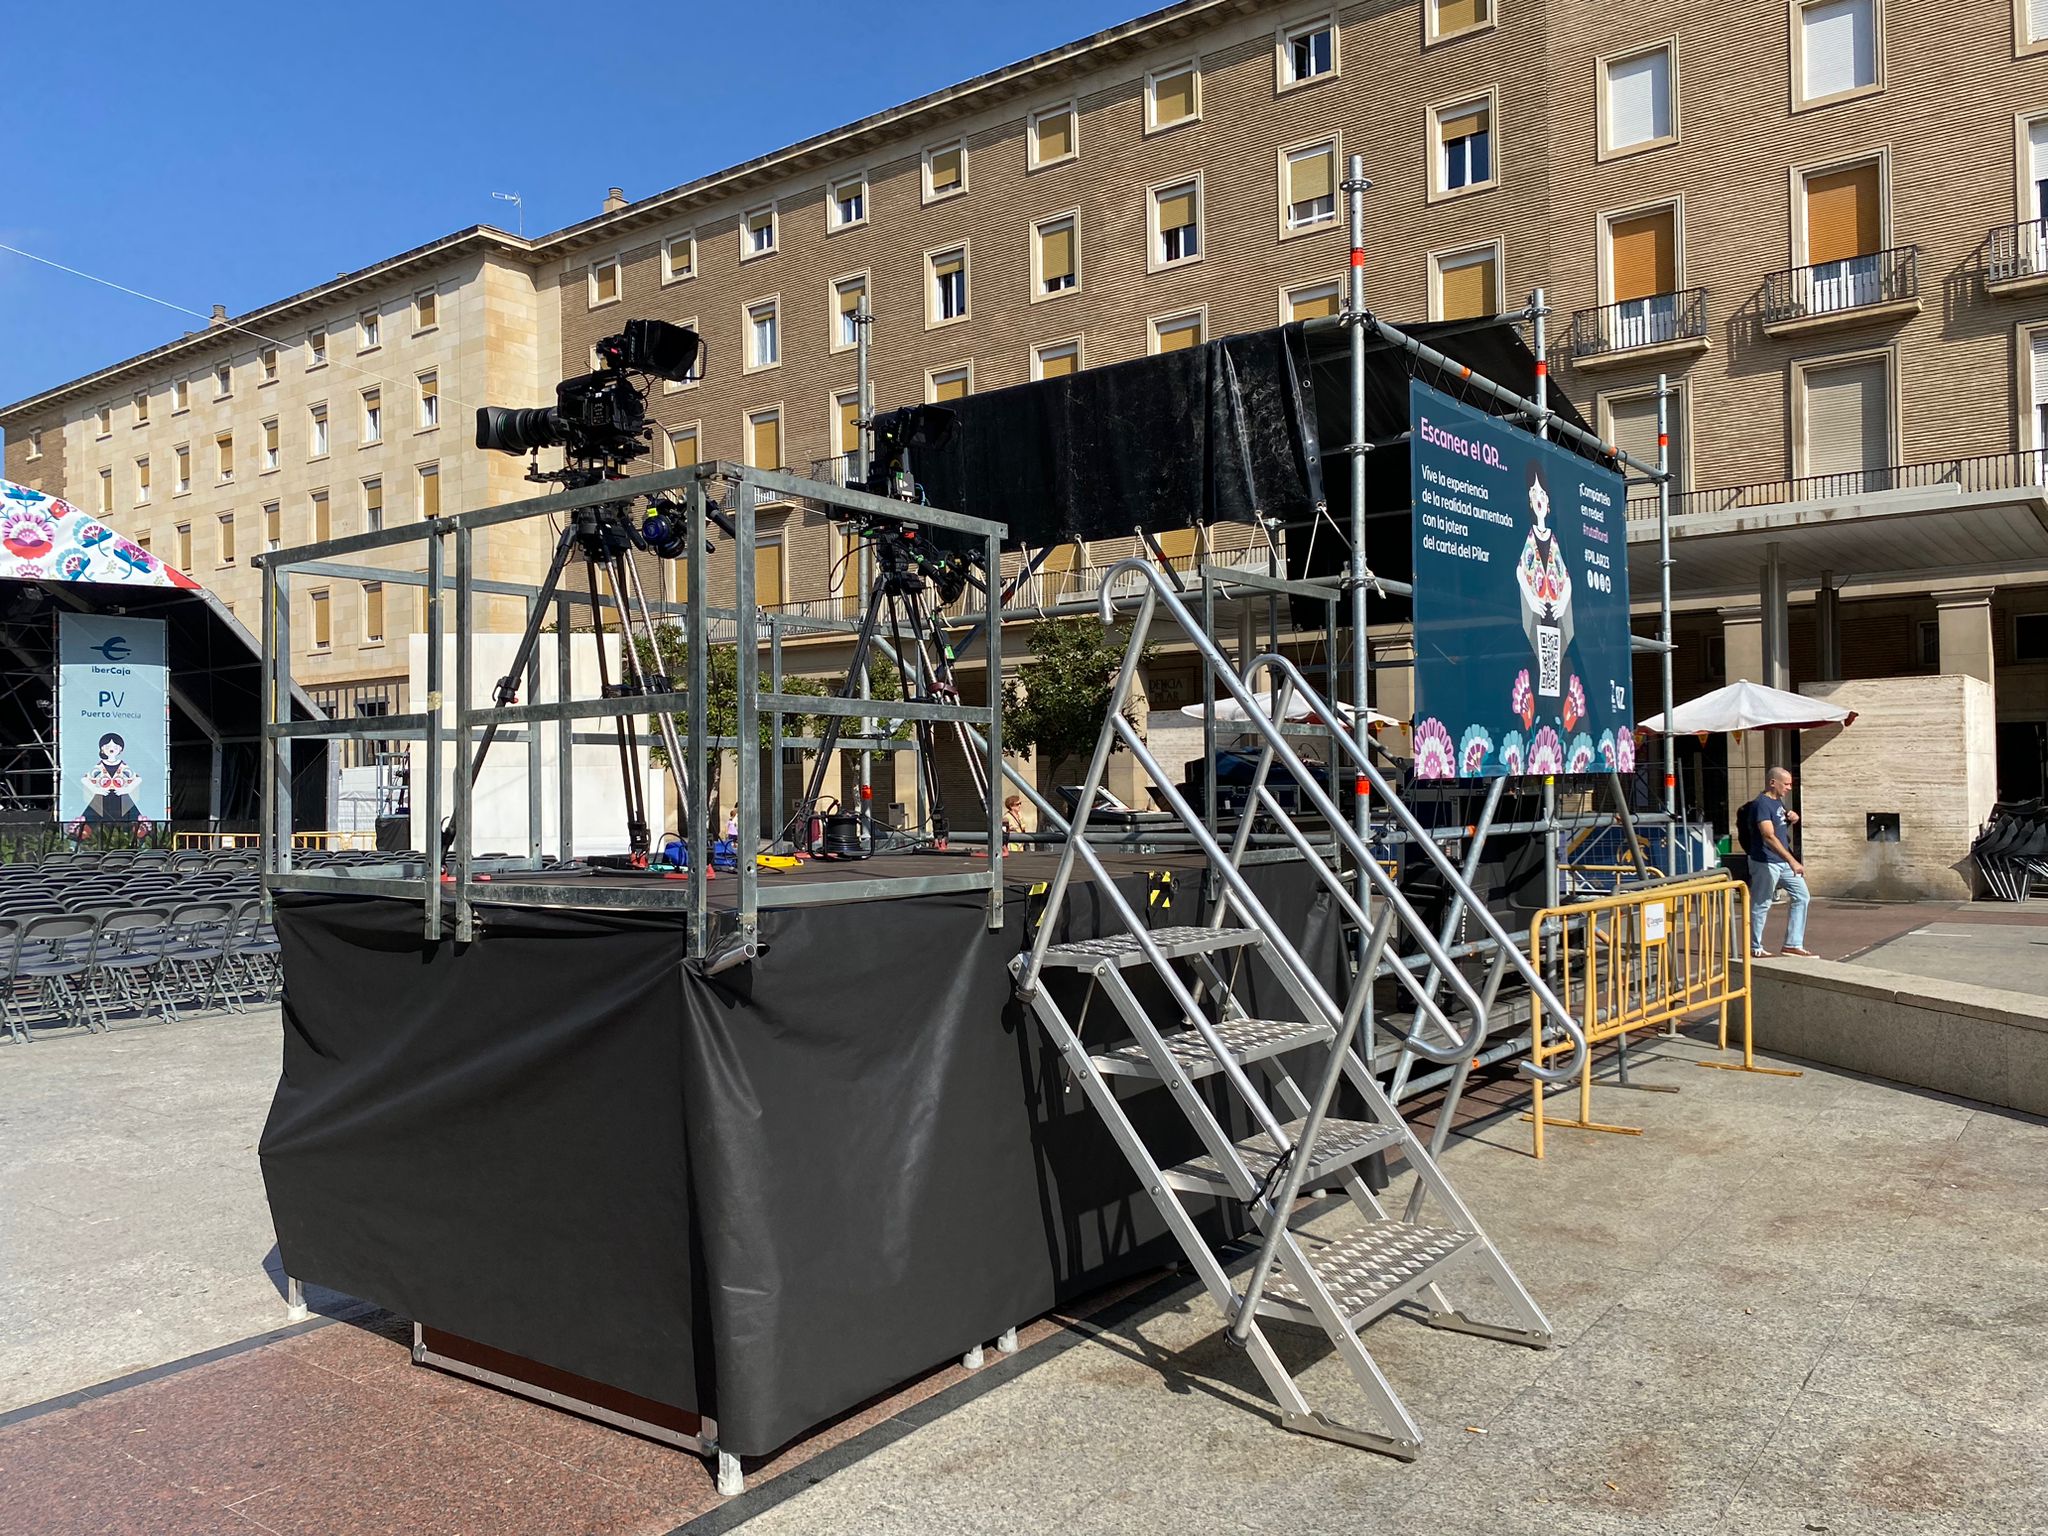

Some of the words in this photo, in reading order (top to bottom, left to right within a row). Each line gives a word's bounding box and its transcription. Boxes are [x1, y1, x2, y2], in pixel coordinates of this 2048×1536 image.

[1421, 417, 1468, 457] Escanea
[1470, 440, 1481, 461] el
[1482, 444, 1508, 472] QR...
[1421, 464, 1438, 483] Vive
[1438, 470, 1446, 487] la
[1446, 478, 1489, 500] experiencia
[1422, 488, 1432, 504] de
[1432, 491, 1441, 507] la
[1441, 494, 1472, 516] realidad
[1472, 506, 1513, 528] aumentada
[1580, 505, 1588, 517] en
[1588, 507, 1605, 523] redes!
[1422, 513, 1436, 529] con
[1436, 515, 1445, 530] la
[1445, 517, 1468, 536] jotera
[1423, 534, 1435, 550] del
[1435, 539, 1457, 556] cartel
[1457, 541, 1471, 559] del
[1471, 545, 1490, 563] Pilar
[91, 666, 131, 676] iberCaja
[99, 691, 125, 708] PV
[81, 710, 111, 718] Puerto
[112, 711, 142, 719] Venecia
